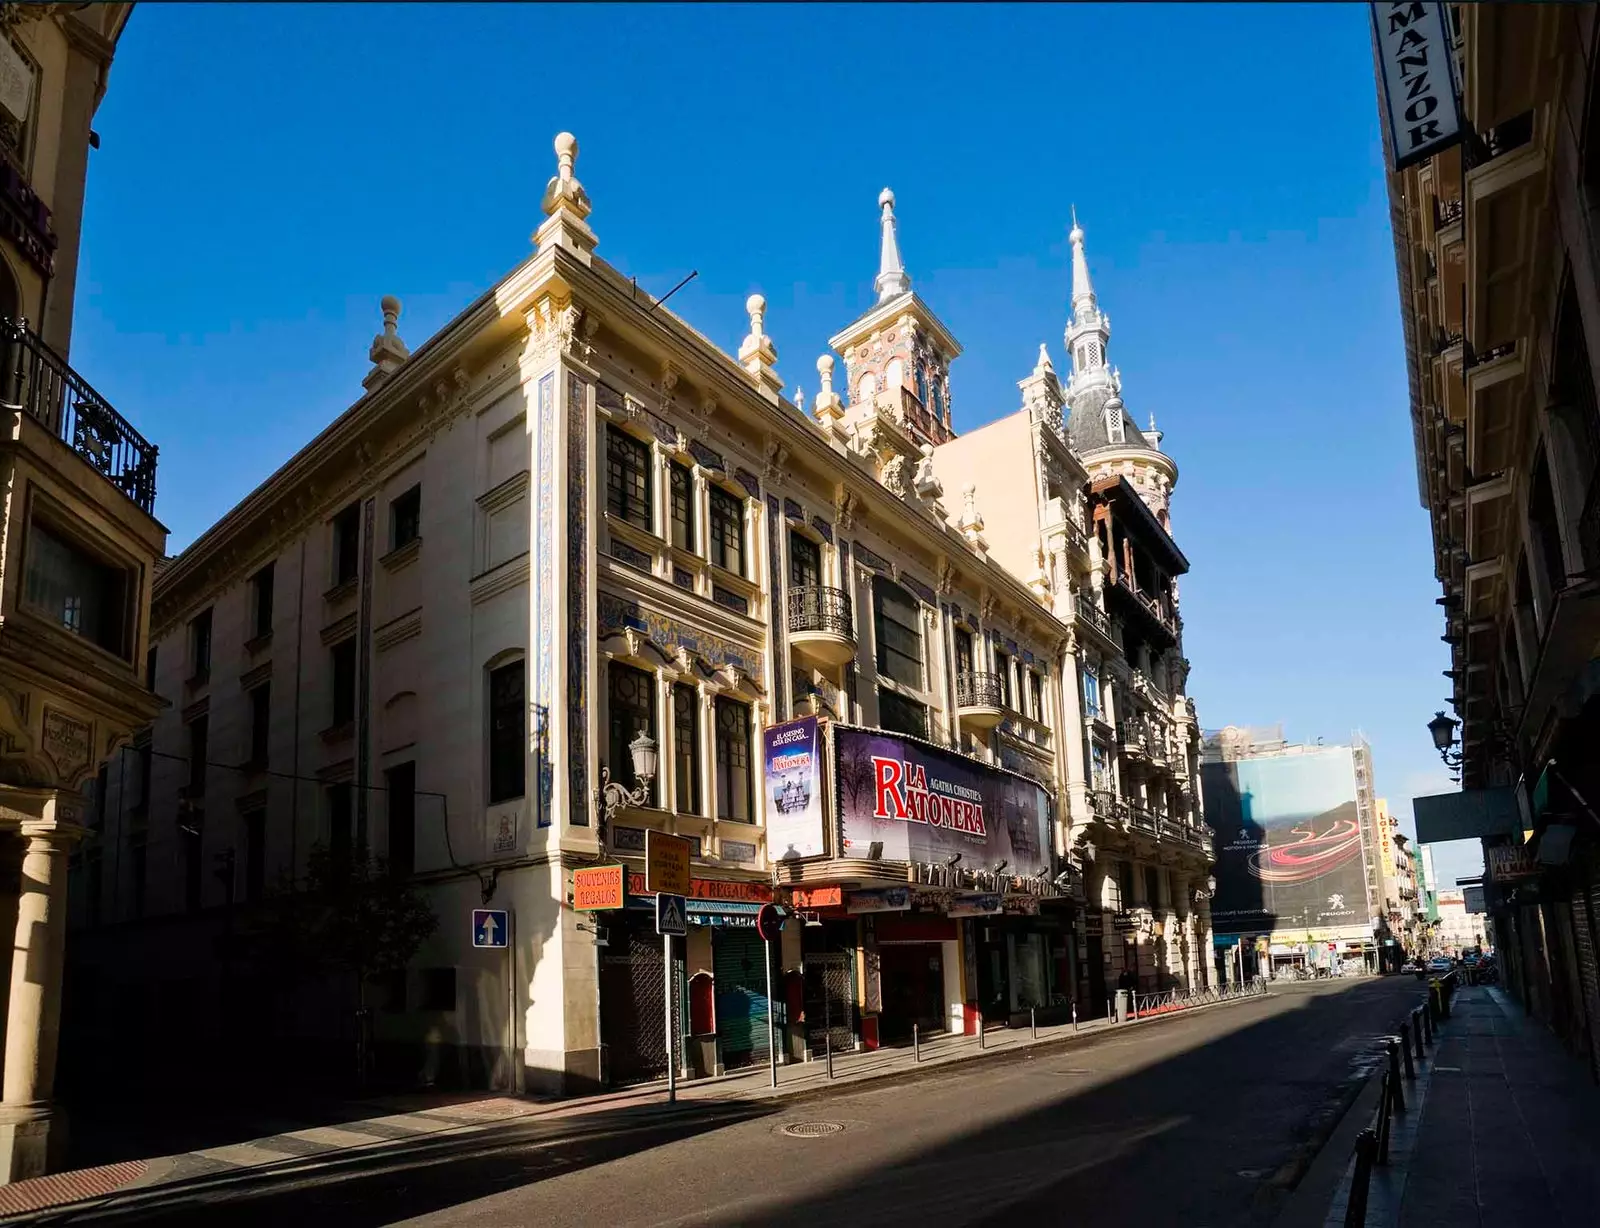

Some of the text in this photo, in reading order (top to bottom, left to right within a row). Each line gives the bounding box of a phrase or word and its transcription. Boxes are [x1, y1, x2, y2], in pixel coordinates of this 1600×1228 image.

[904, 760, 928, 791] LA
[929, 777, 953, 794] AGATHA
[871, 756, 987, 837] RATONERA
[576, 870, 620, 888] SOUVENIRS
[579, 888, 617, 906] REGALOS
[1320, 909, 1356, 917] PEUGEOT
